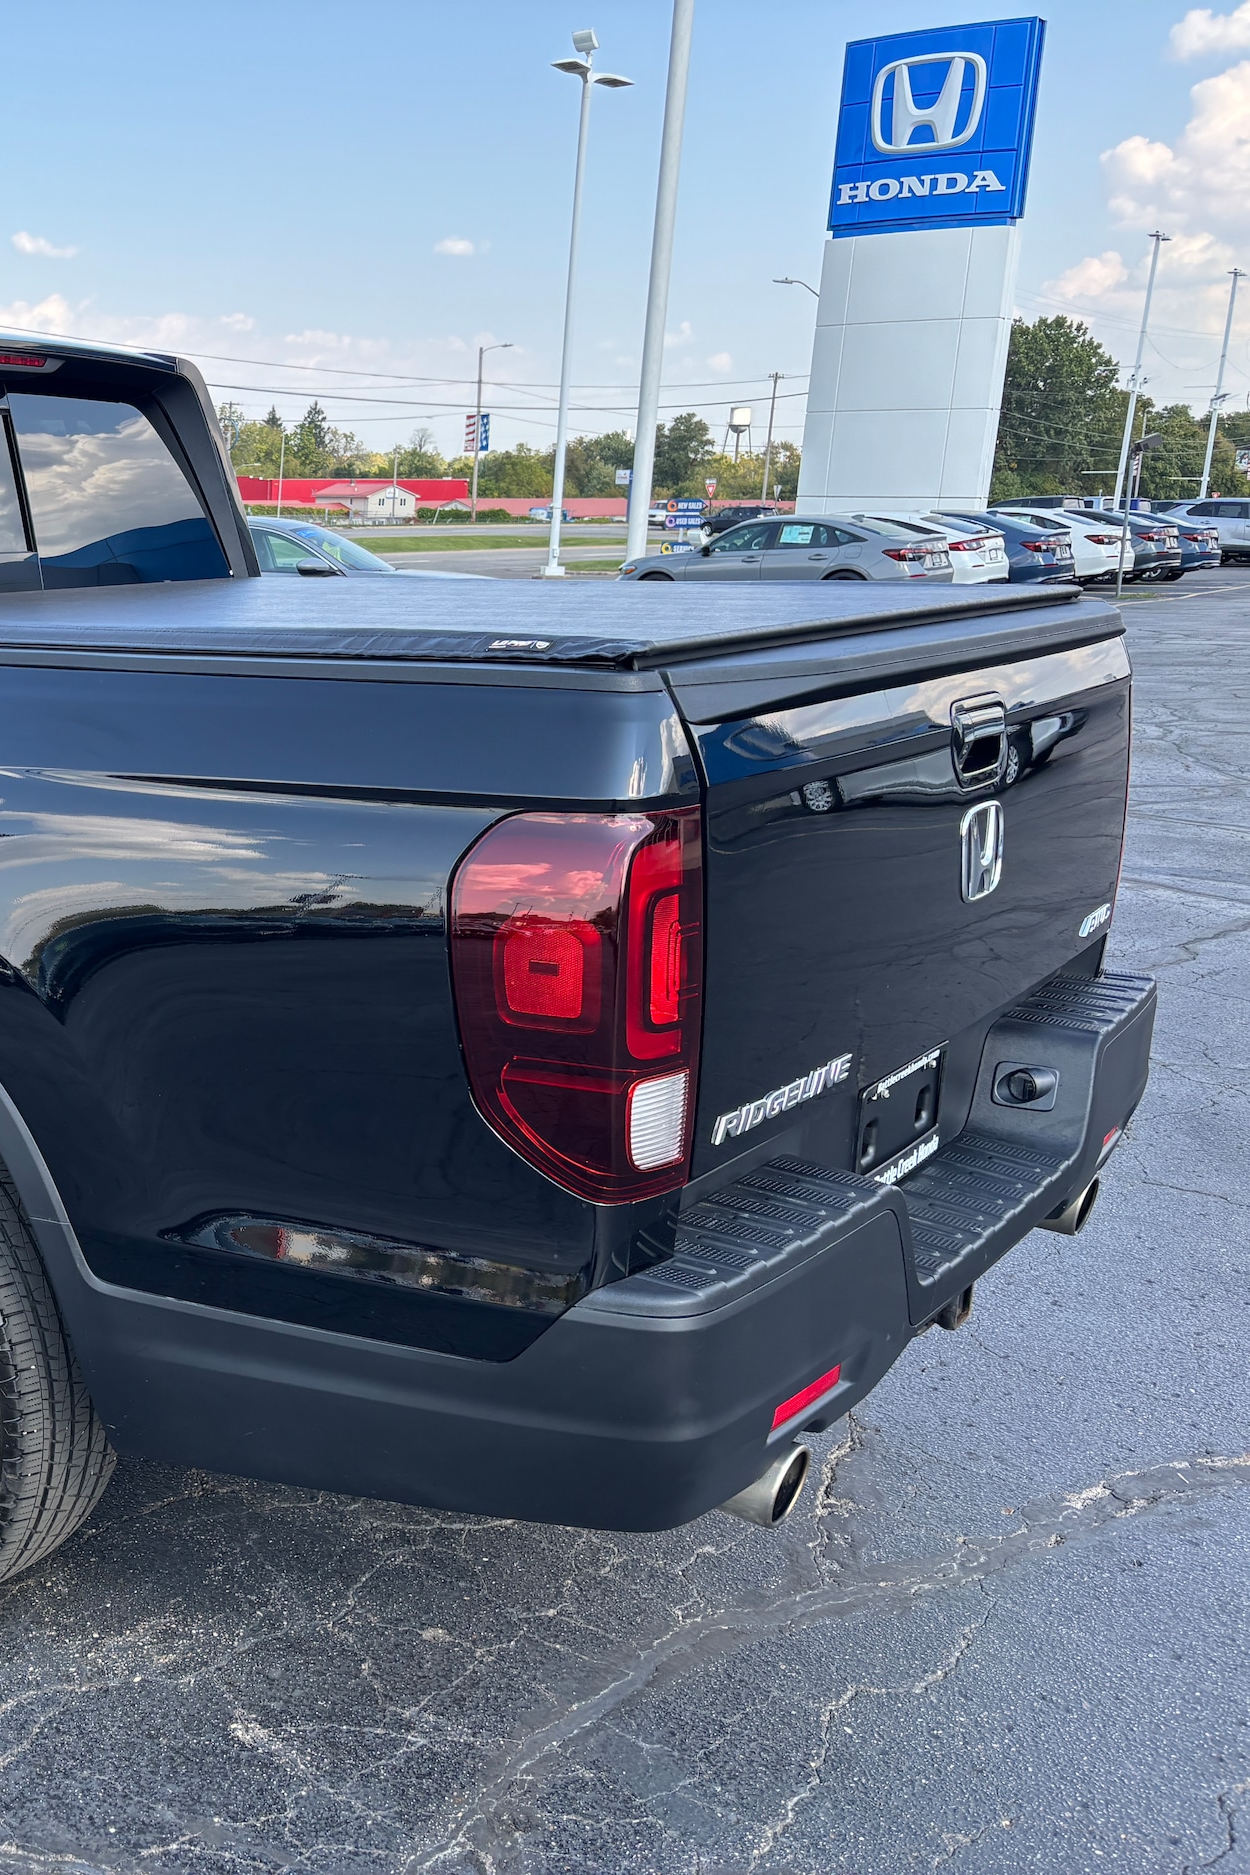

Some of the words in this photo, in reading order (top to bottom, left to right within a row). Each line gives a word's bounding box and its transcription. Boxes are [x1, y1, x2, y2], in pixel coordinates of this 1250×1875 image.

[836, 170, 1006, 205] HONDA
[676, 517, 688, 525] USED
[687, 517, 701, 525] SALES
[677, 502, 688, 510] NEW
[688, 502, 703, 510] SALES
[711, 1053, 853, 1146] RIDGELINE
[897, 1148, 918, 1179] Creek
[917, 1134, 940, 1165] Honda
